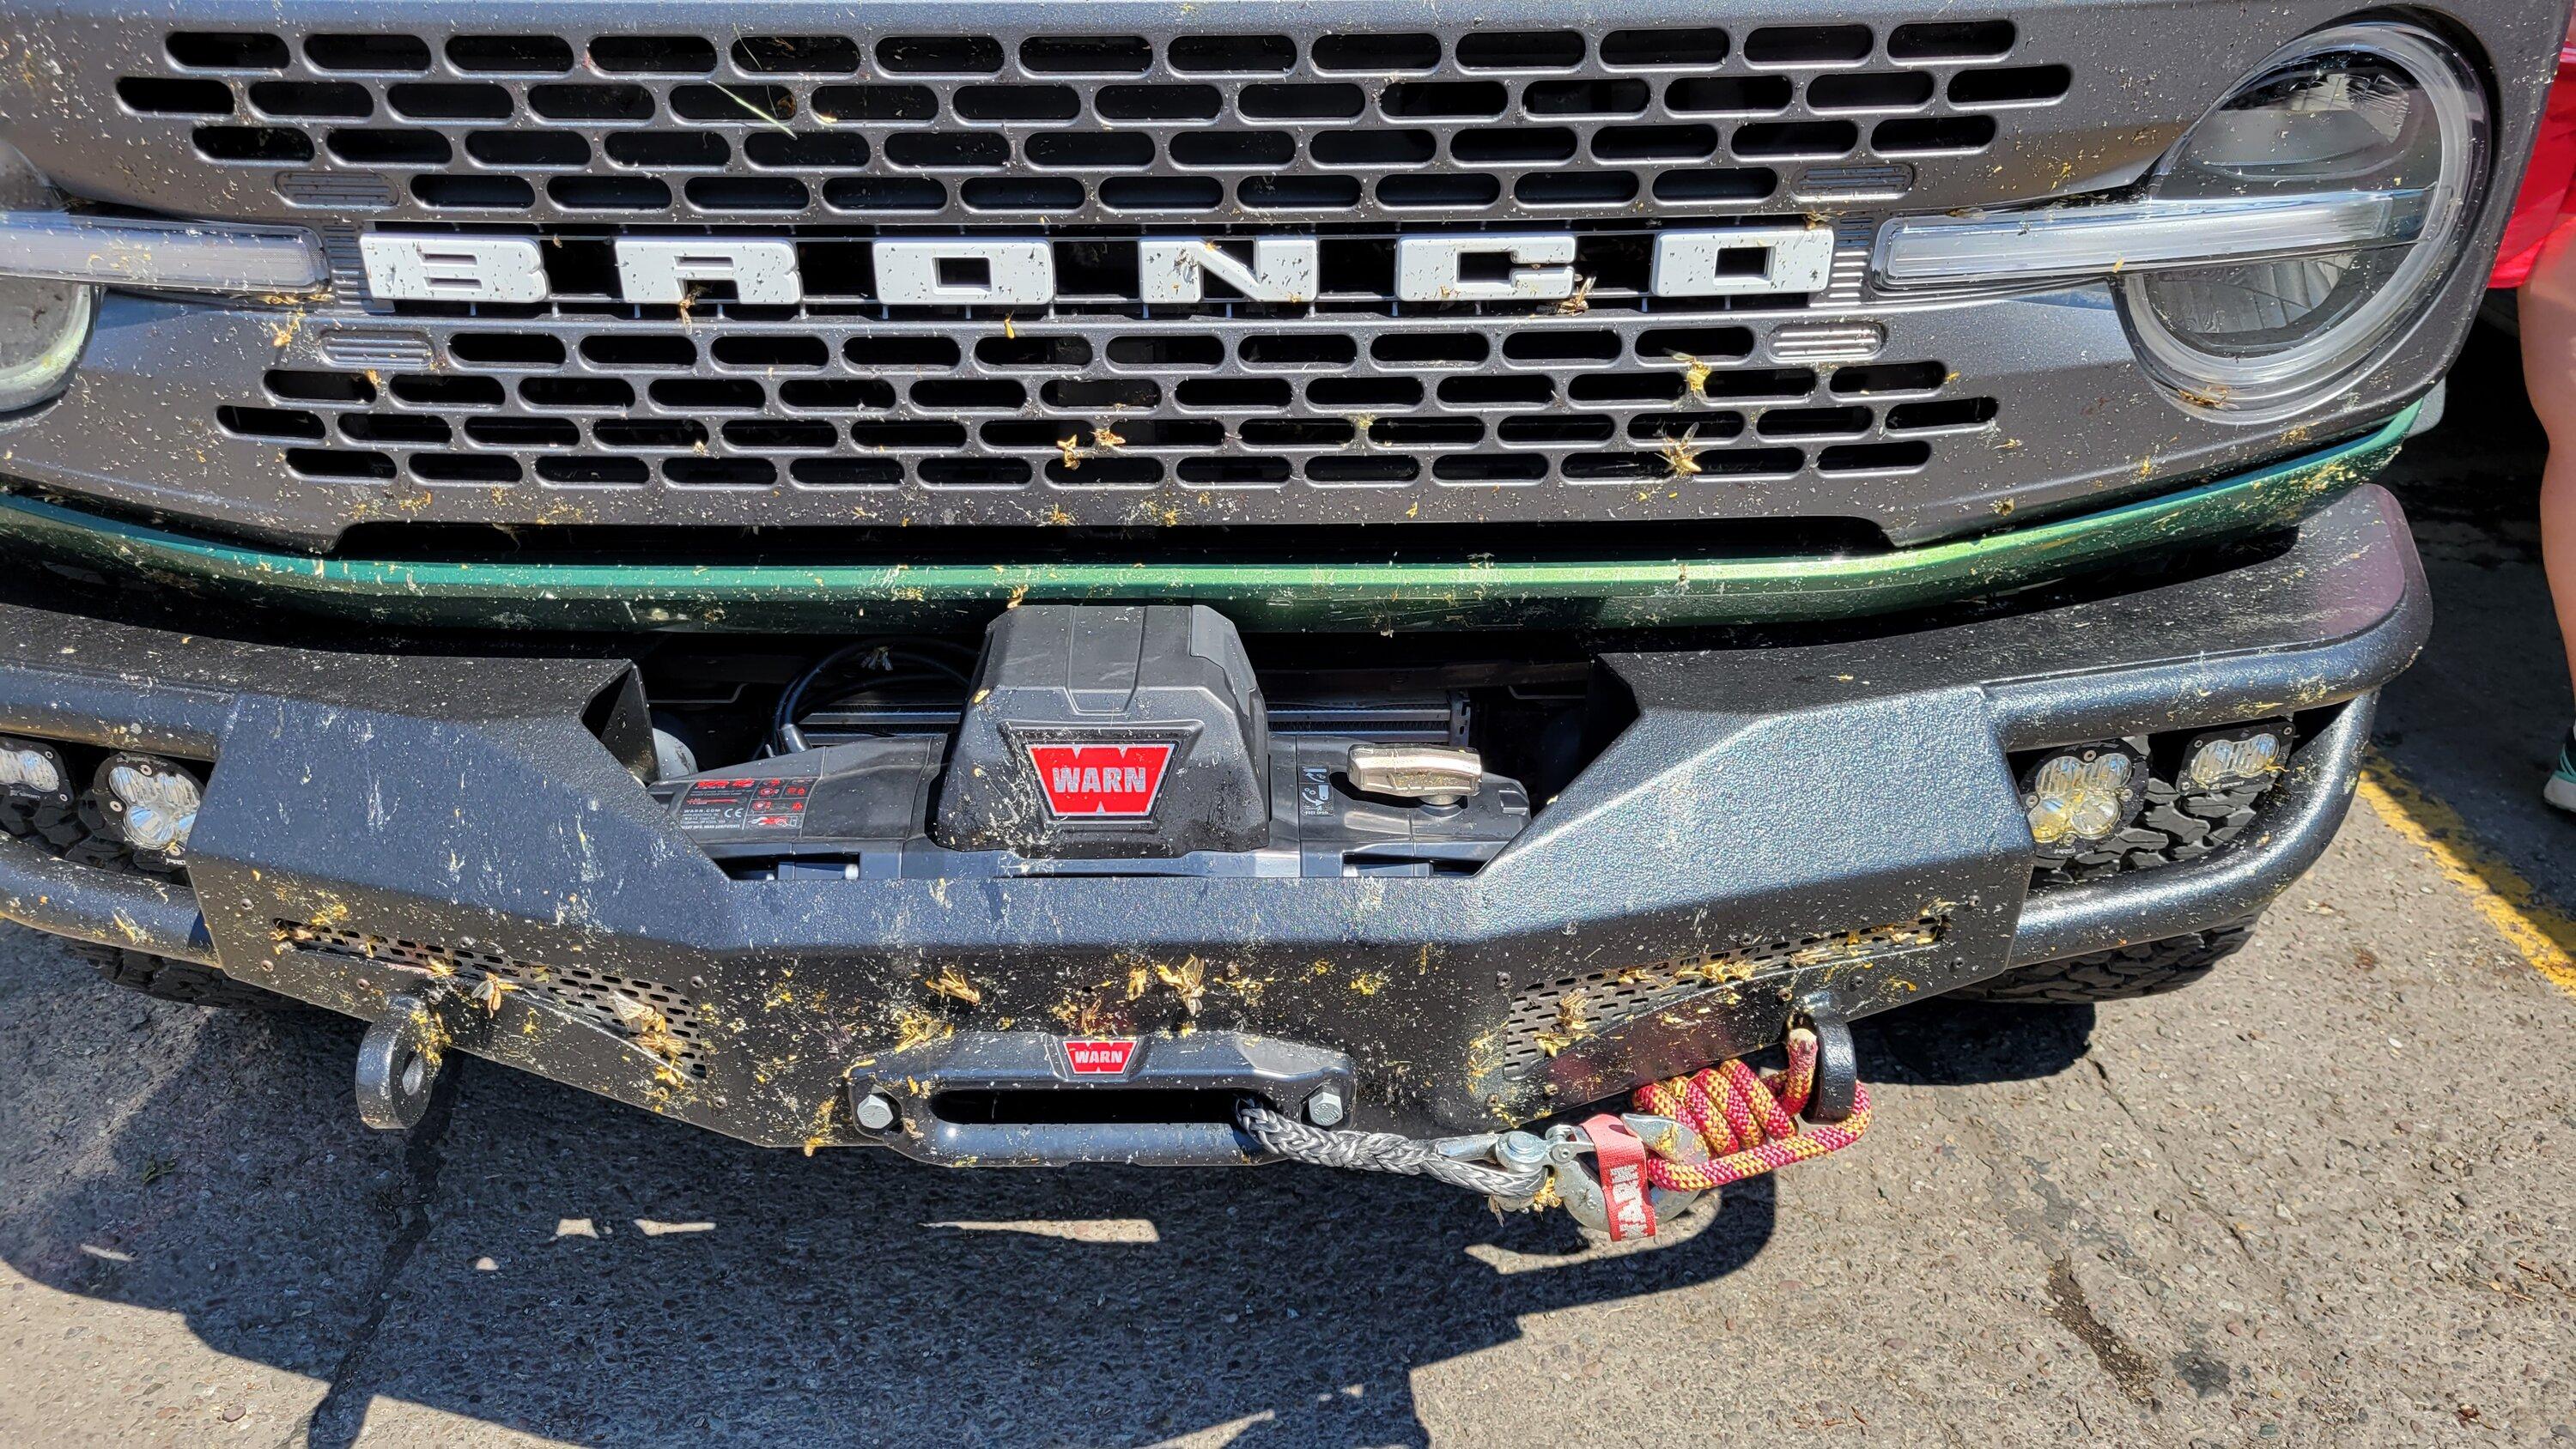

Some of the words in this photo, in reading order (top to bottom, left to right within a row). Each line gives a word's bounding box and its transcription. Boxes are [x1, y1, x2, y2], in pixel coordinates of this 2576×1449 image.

[359, 227, 1834, 305] BRONCO
[1052, 767, 1146, 793] WARN
[724, 808, 744, 818] CE
[1074, 1050, 1123, 1064] WARN
